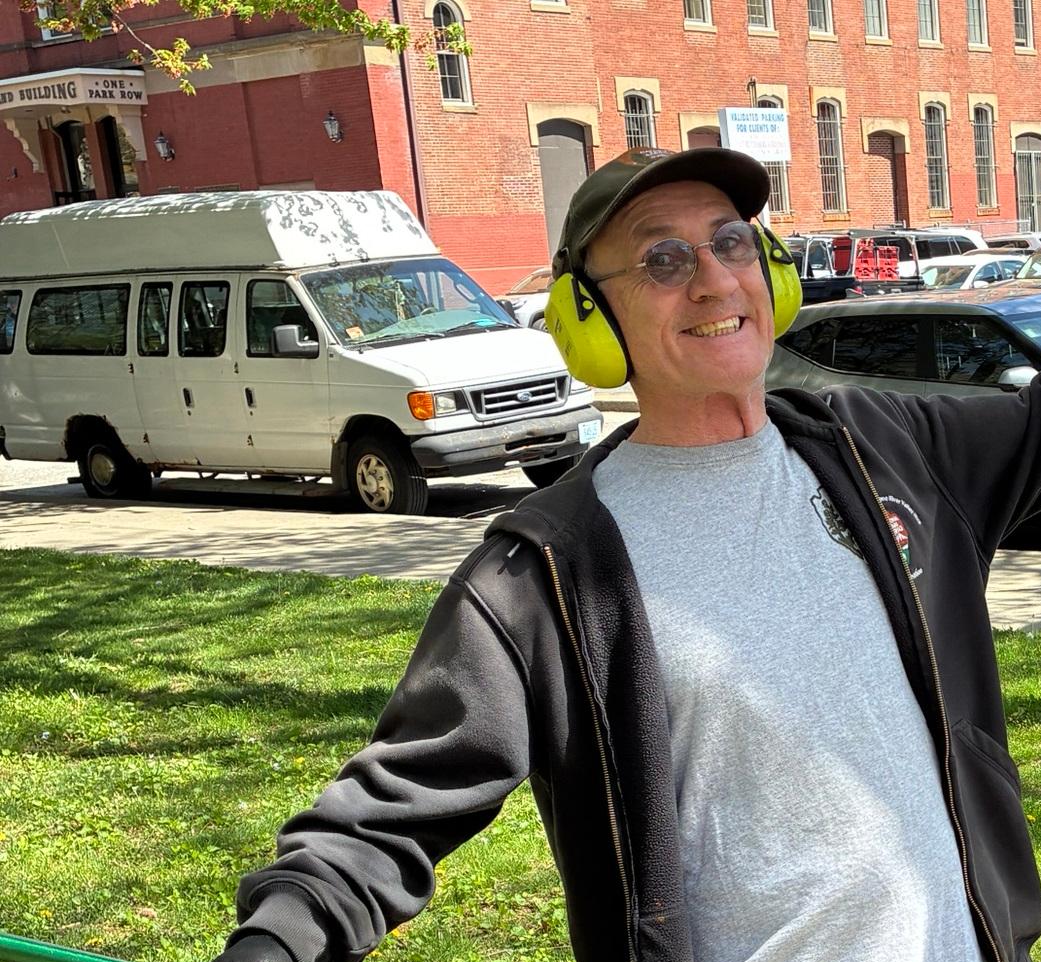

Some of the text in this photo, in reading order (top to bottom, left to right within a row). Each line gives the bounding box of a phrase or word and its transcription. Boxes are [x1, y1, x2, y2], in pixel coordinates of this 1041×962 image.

[103, 79, 125, 89] ONE
[19, 81, 77, 101] BUILDING
[88, 89, 143, 100] PARK ROW
[731, 113, 784, 122] VALIDATED PARKING
[736, 124, 747, 132] FOR
[749, 124, 769, 132] CLIENTS
